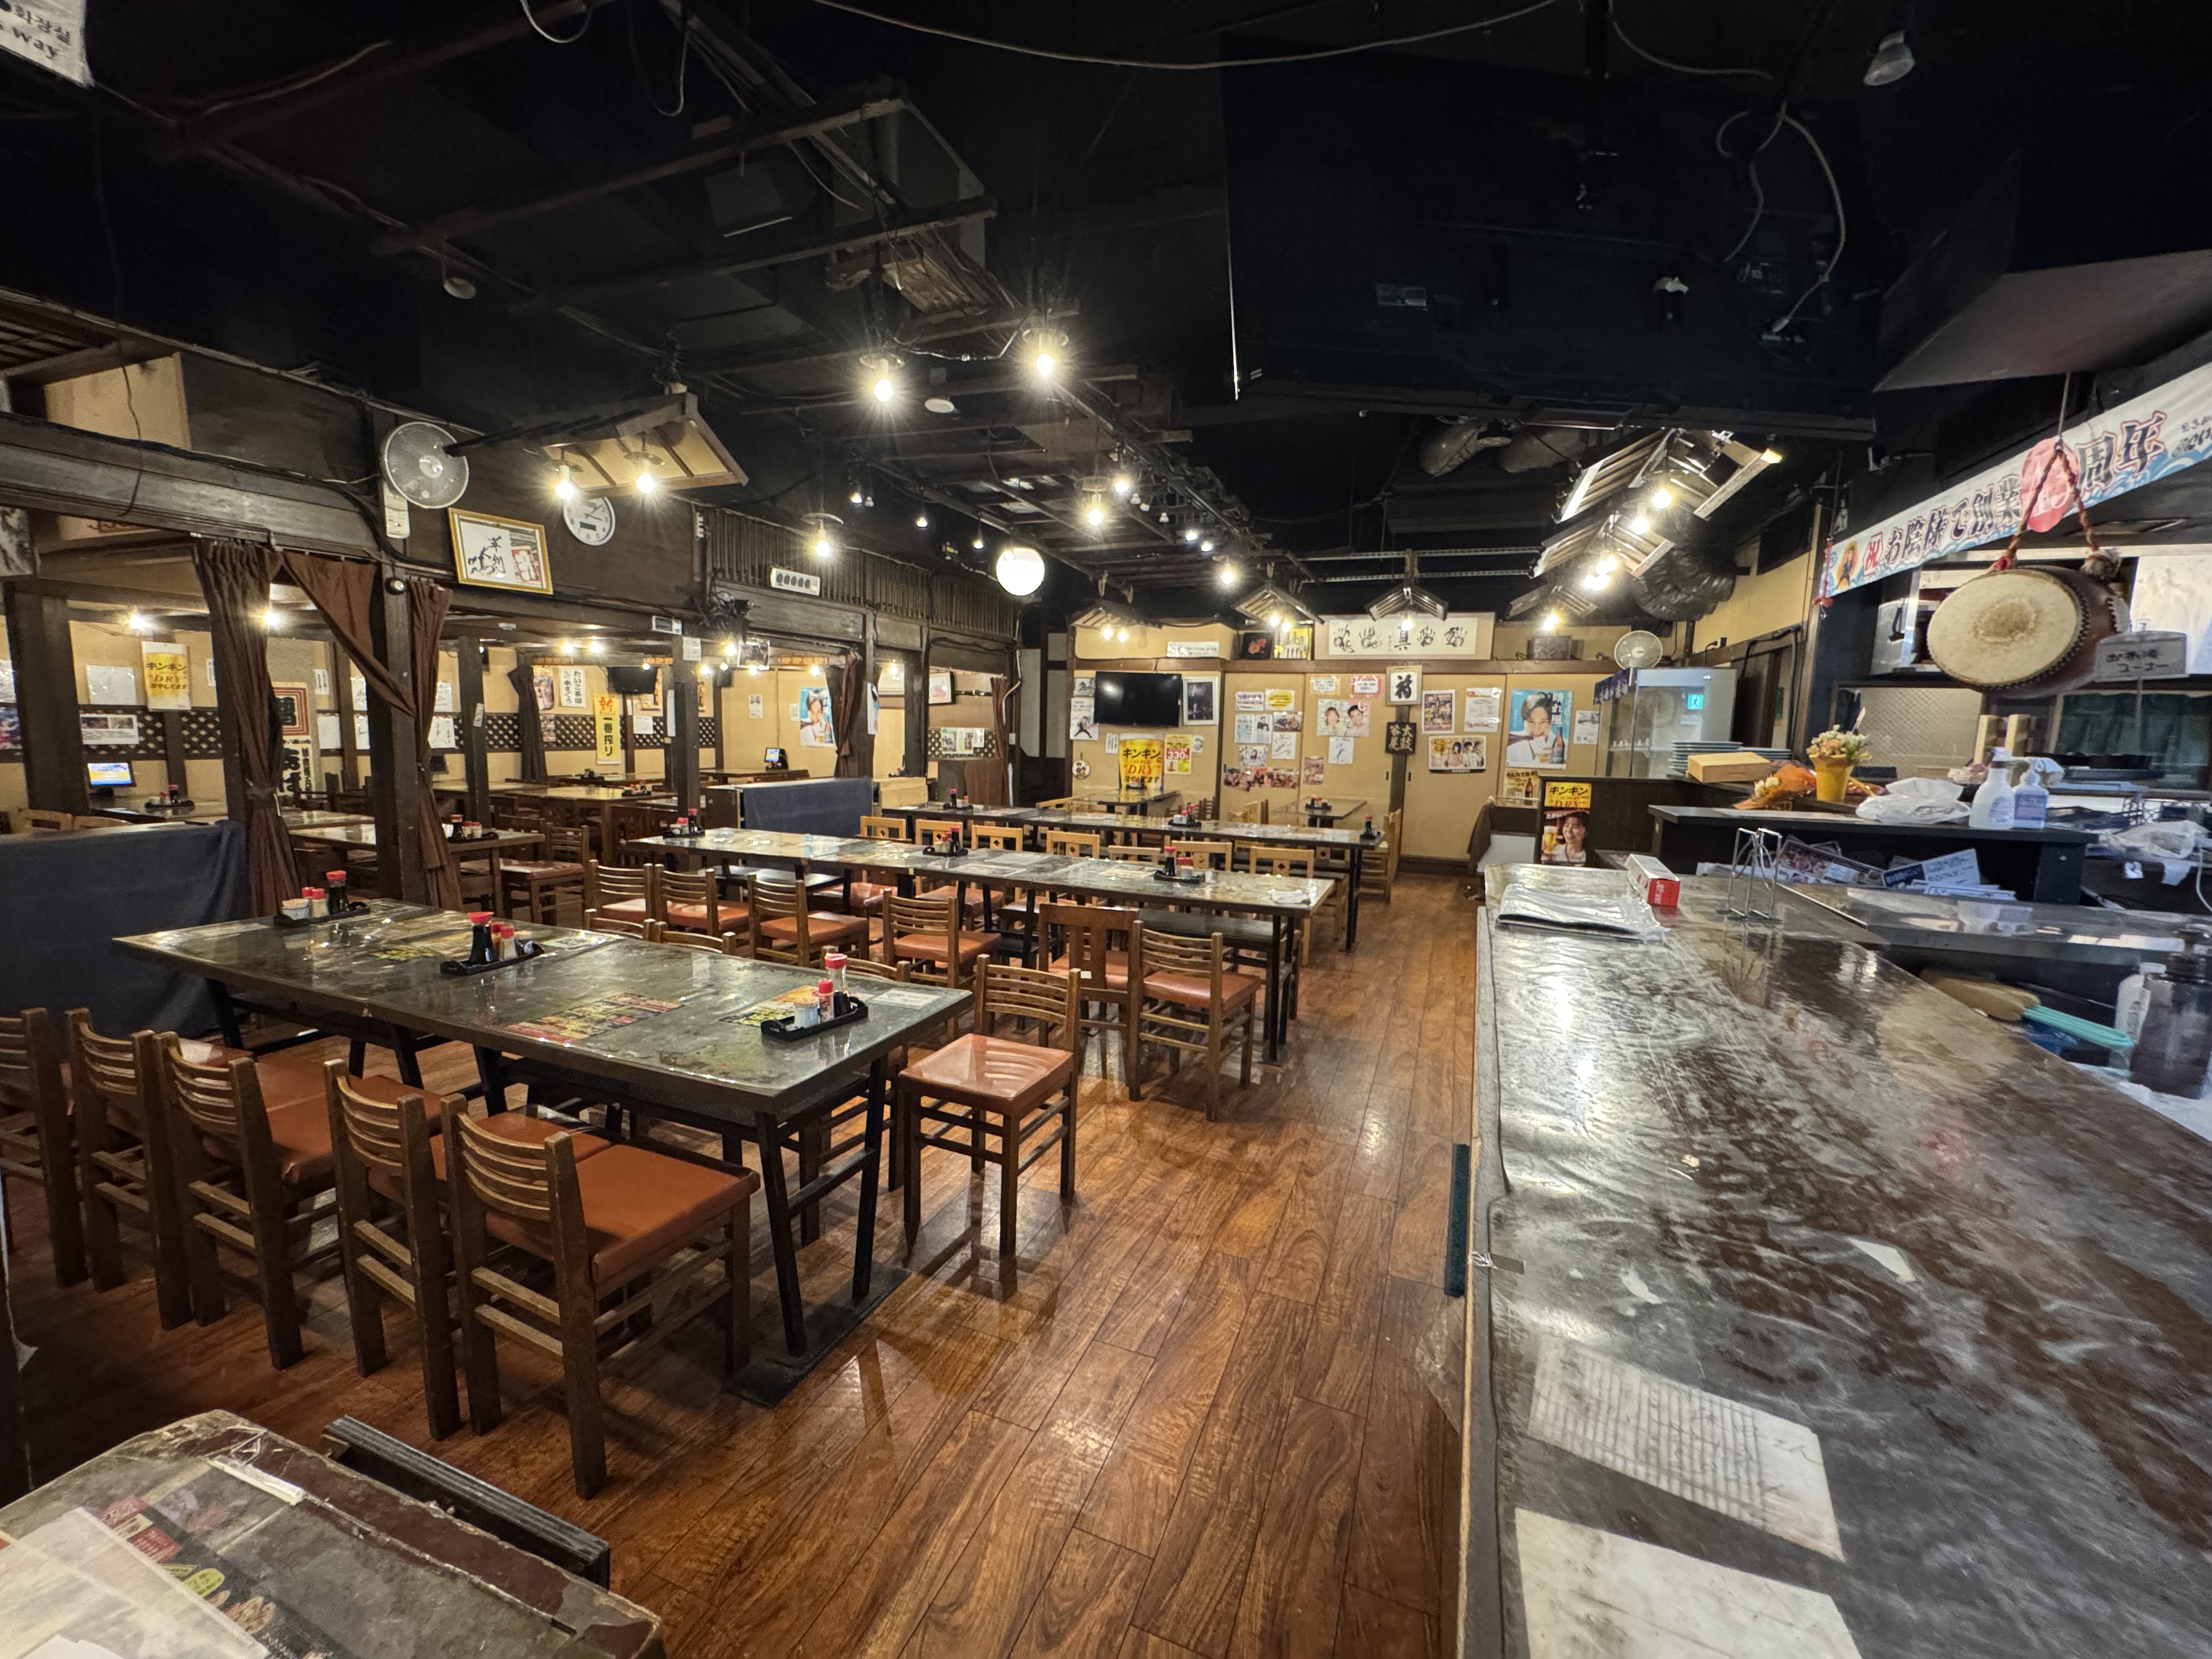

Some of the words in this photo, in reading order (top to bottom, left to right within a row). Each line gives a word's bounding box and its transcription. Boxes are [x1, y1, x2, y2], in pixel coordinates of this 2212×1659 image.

[14, 5, 71, 45] 화장실
[146, 662, 187, 671] キンキン
[599, 697, 613, 712] 新
[603, 717, 613, 756] 一番搾り
[1122, 748, 1161, 759] キンキン
[1167, 751, 1186, 759] 330
[1127, 765, 1154, 775] DRY
[1549, 786, 1588, 795] キンキン
